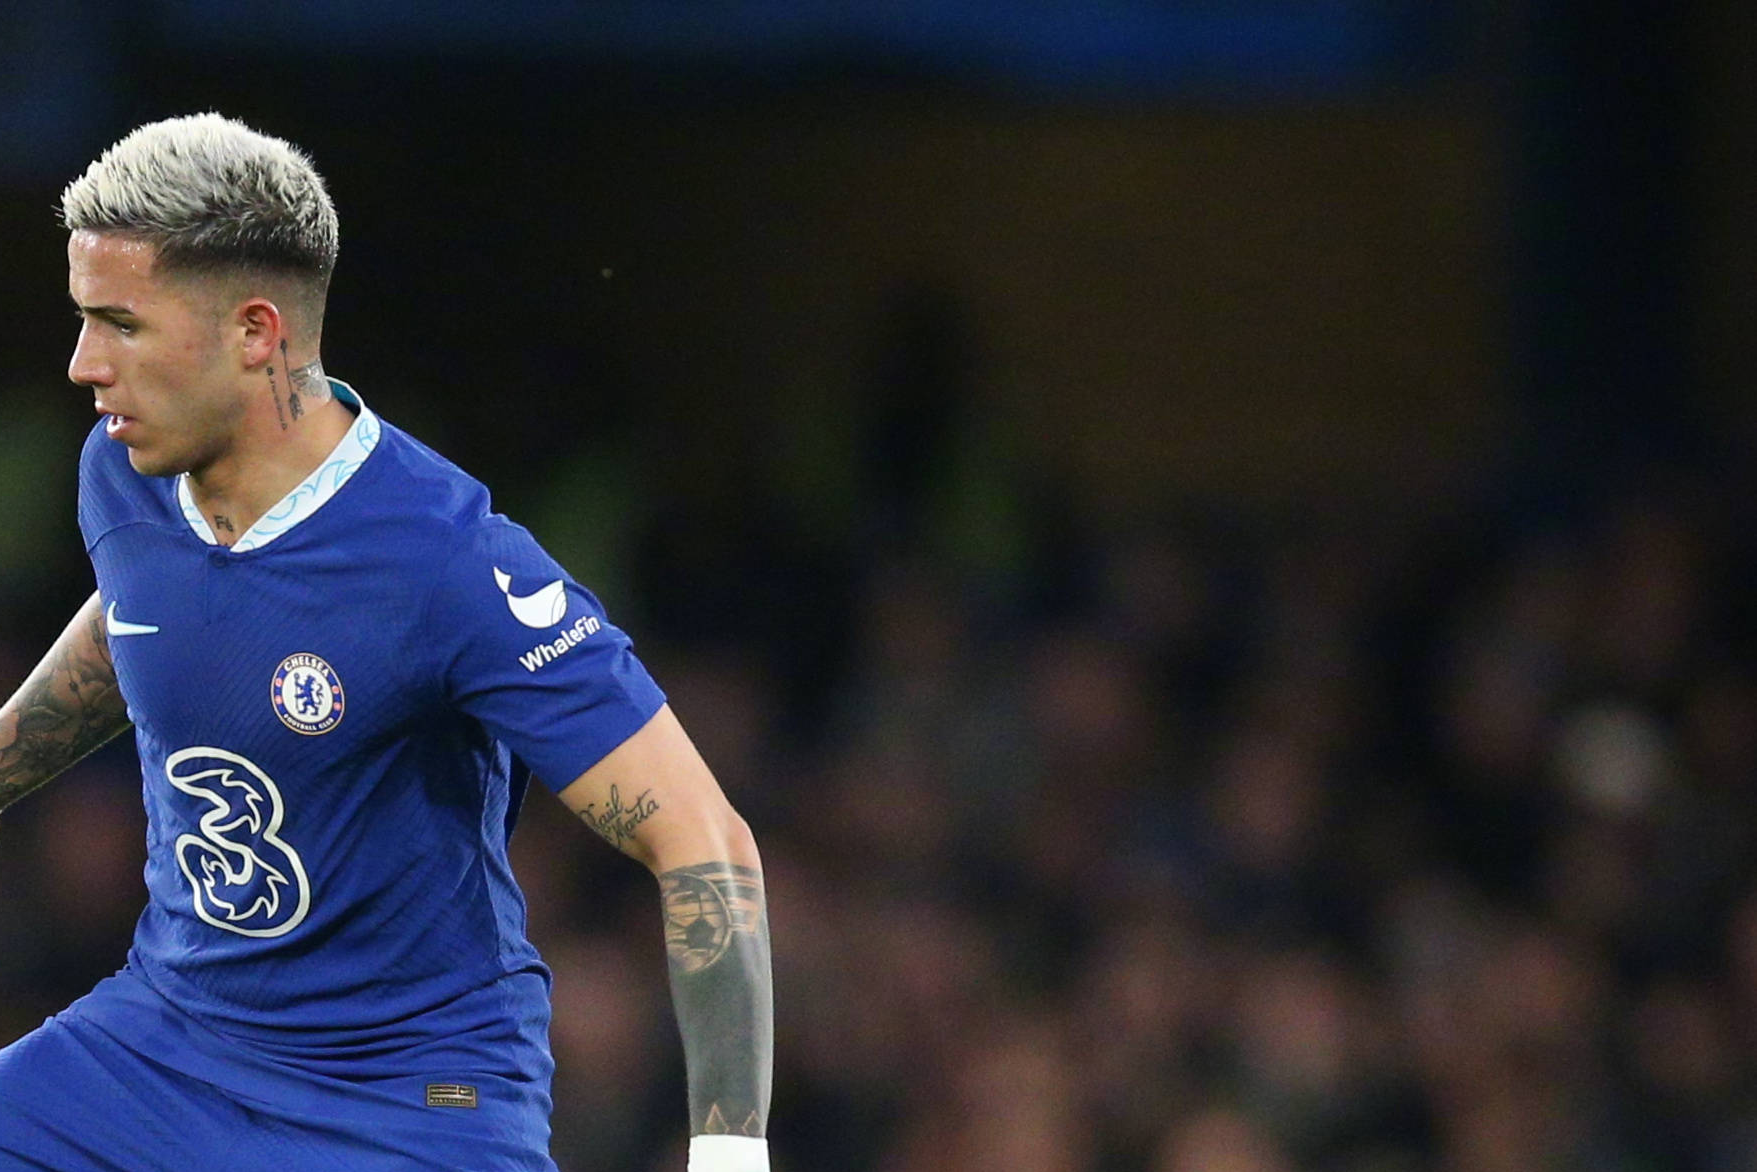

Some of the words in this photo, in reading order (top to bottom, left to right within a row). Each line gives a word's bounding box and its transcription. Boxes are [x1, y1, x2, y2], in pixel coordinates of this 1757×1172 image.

[518, 615, 601, 673] WhaleFin
[283, 655, 329, 677] CHELSEA
[283, 713, 318, 731] FOOTBALL
[318, 717, 334, 729] CLUB
